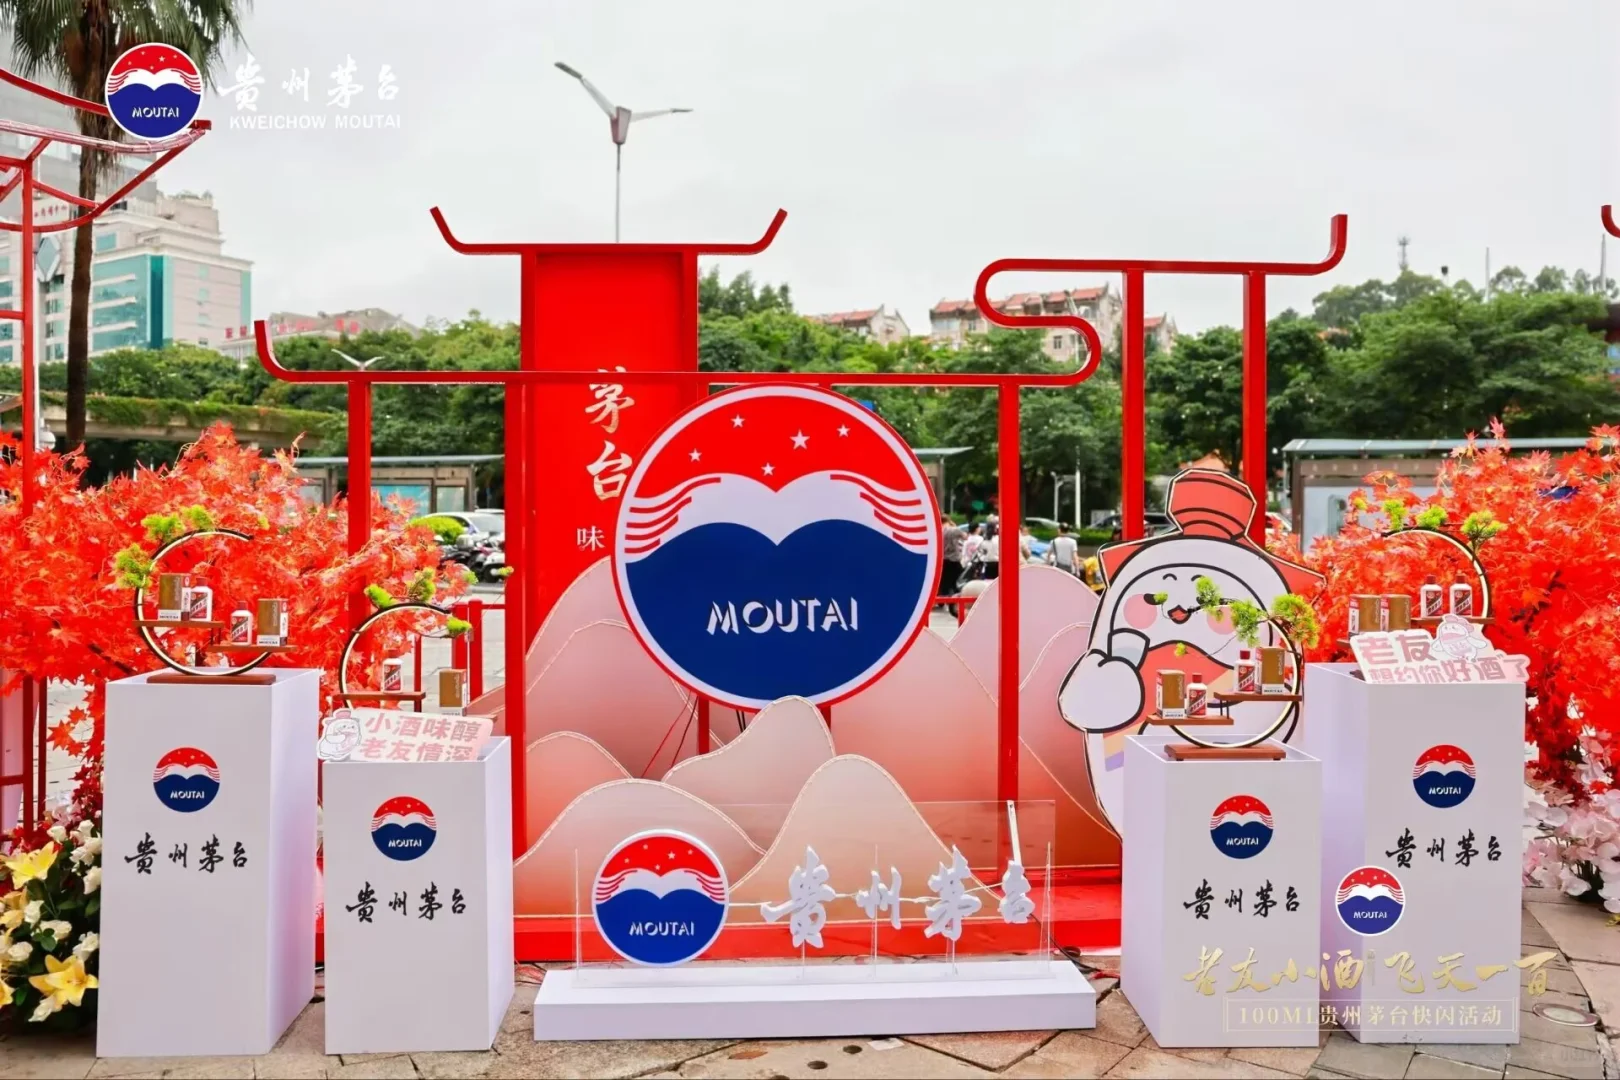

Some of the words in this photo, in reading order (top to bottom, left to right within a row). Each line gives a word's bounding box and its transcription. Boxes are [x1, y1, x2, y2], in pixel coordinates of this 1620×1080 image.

[706, 597, 859, 636] MOUTAI
[1357, 634, 1438, 664] 老友
[365, 712, 482, 742] 小酒味醇
[359, 737, 474, 761] 老友情深
[170, 790, 205, 799] MOUTAI
[1428, 787, 1462, 795] MOUTAI
[388, 838, 422, 848] MOUTAI
[1226, 837, 1259, 846] MOUTAI
[628, 921, 695, 936] MOUTAI
